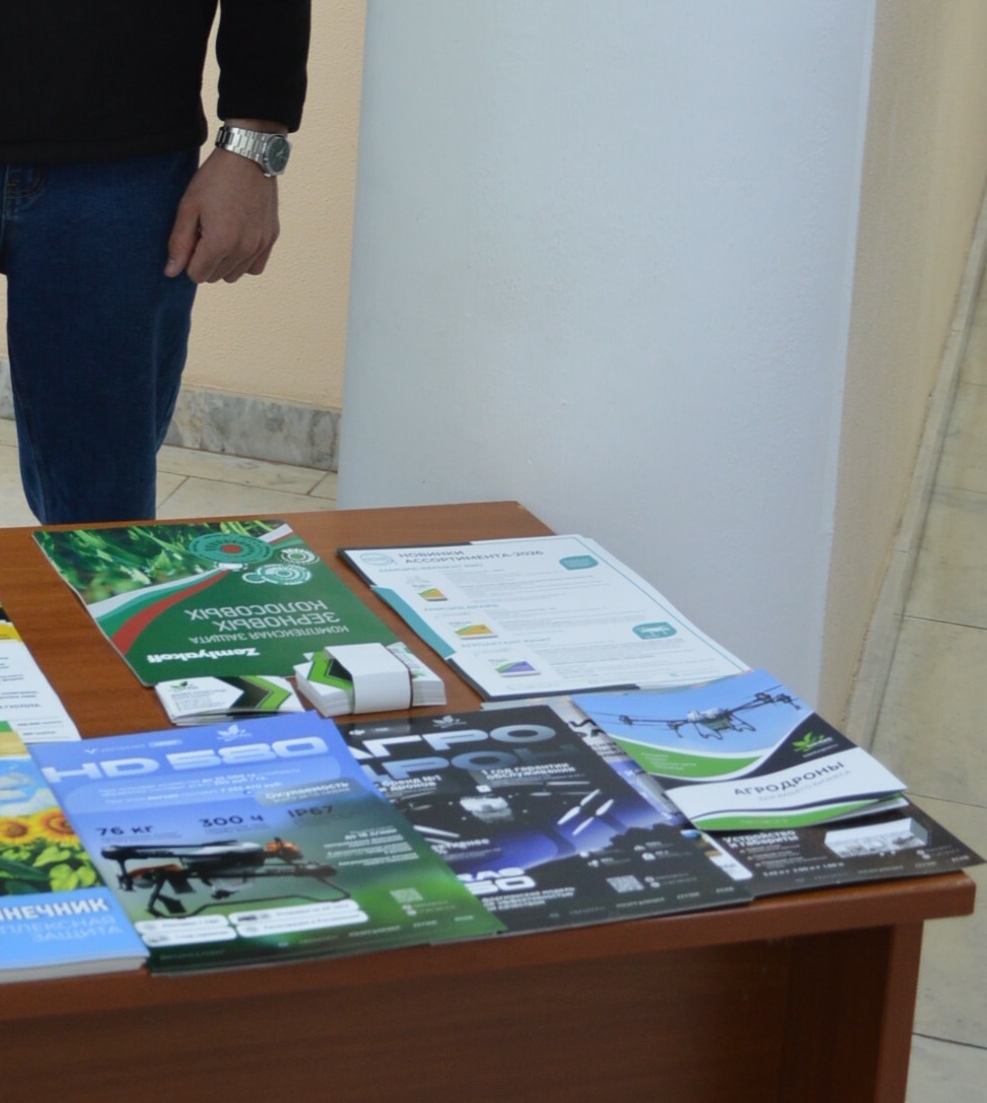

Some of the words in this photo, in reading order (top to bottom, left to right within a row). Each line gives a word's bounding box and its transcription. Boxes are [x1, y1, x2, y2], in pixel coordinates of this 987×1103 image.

[398, 550, 464, 559] НОВИНКИ
[184, 600, 328, 621] КОЛОСОВЫХ
[213, 612, 340, 632] ЗЕРНОВЫХ
[188, 633, 247, 645] ЗАЩИТА
[249, 625, 349, 640] КОМПЛЕКСНАЯ
[147, 647, 260, 664] Zemlyakoff
[41, 757, 160, 783] HD
[167, 736, 330, 772] 580
[734, 761, 845, 796] АГРОДРОНЫ
[266, 782, 350, 800] Окупаемость
[287, 805, 334, 819] IP67
[199, 815, 244, 828] 300
[250, 813, 265, 823] ч
[96, 826, 125, 837] 76
[131, 825, 154, 836] кг
[723, 830, 796, 844] Устройство
[32, 925, 124, 943] ЗАЩИТА
